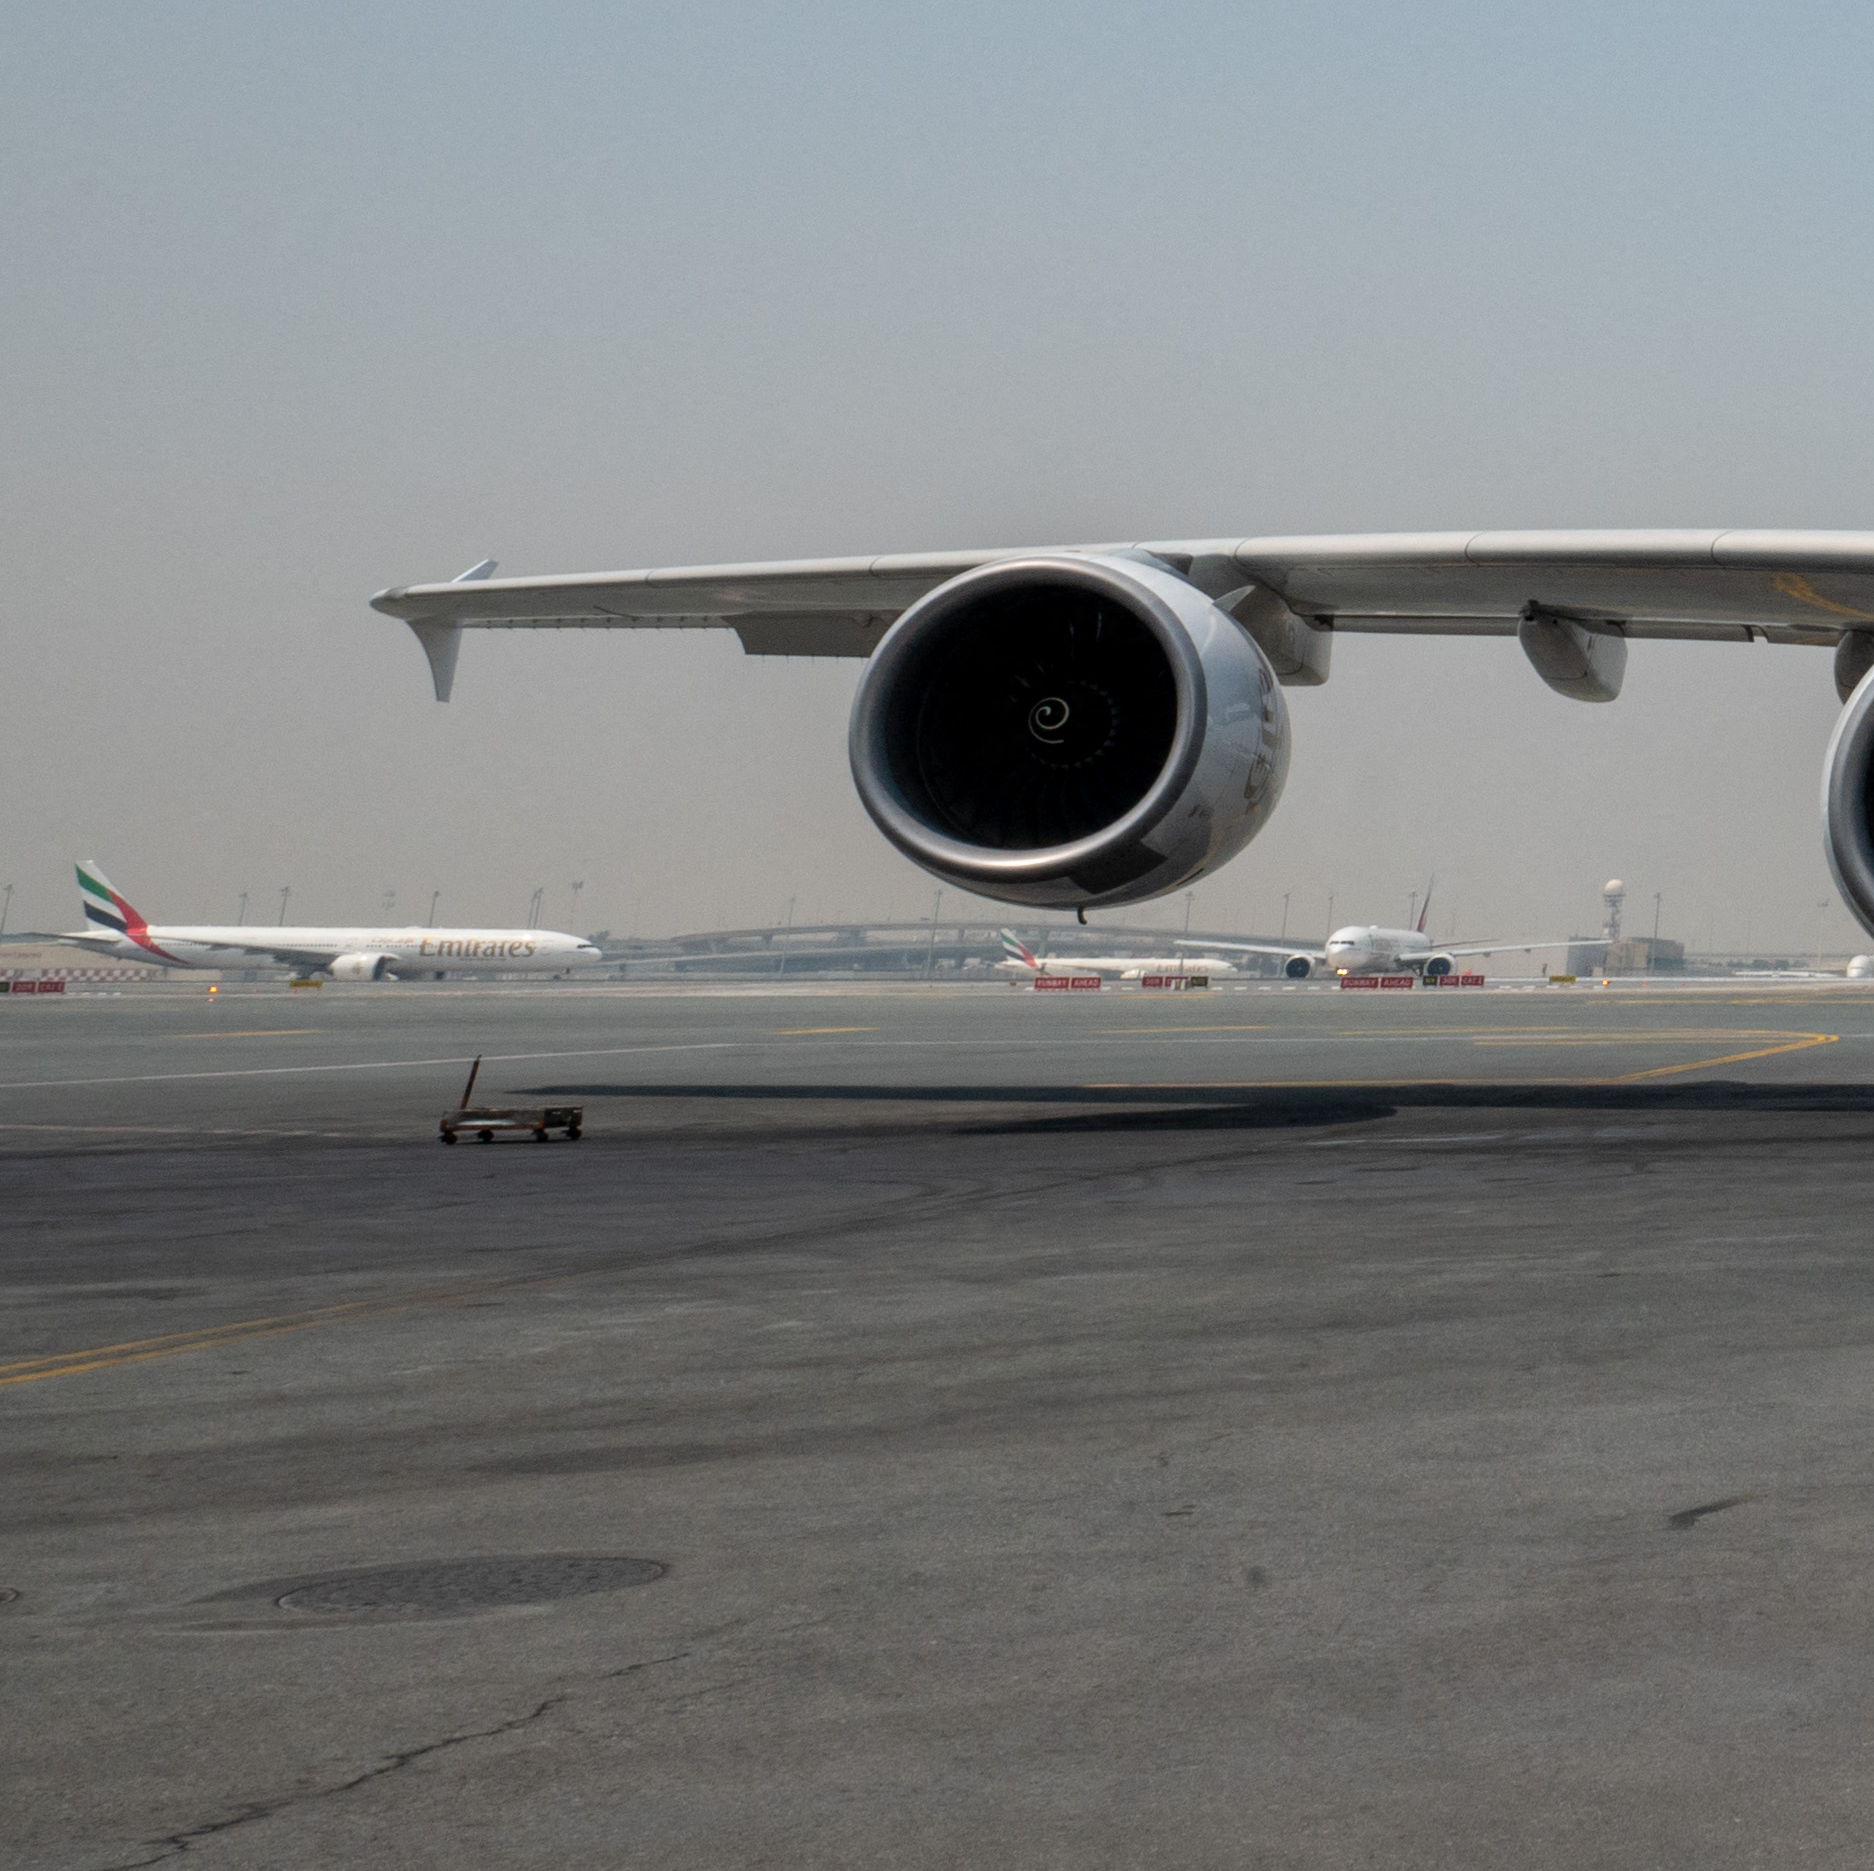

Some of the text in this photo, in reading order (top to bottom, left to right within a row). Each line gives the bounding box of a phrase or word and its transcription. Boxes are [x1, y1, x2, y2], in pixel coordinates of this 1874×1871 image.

[419, 937, 537, 959] Emirates
[1073, 978, 1099, 987] AHEAD
[1382, 978, 1411, 987] AHEAD
